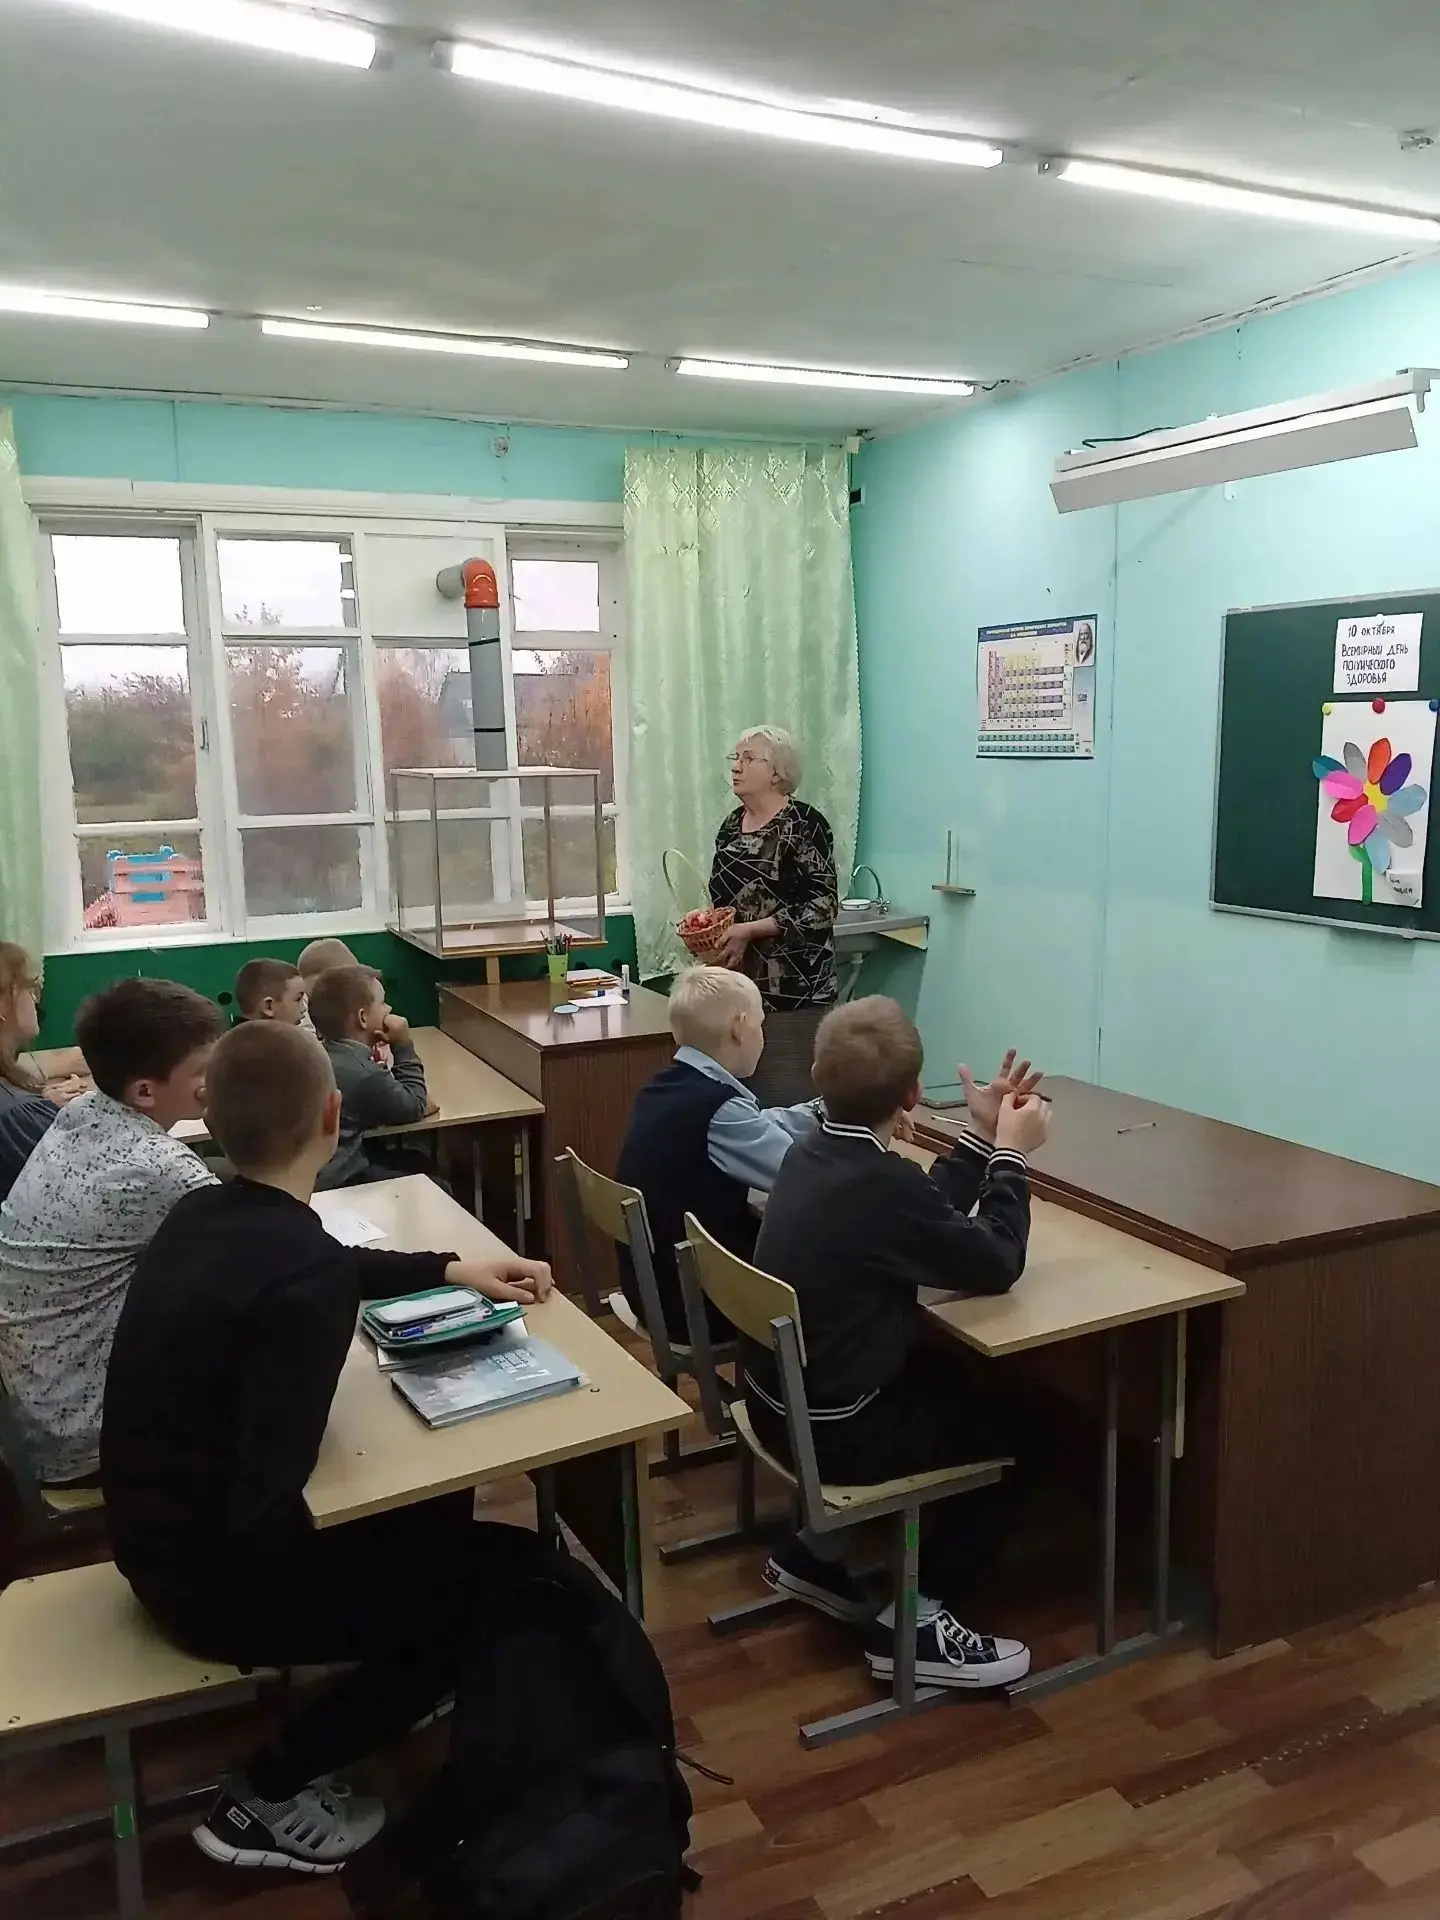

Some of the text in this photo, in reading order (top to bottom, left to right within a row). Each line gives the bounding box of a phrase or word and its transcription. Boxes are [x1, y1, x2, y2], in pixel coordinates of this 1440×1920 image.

[1348, 624, 1357, 637] 10
[1386, 643, 1409, 656] ДЕНЬ
[1346, 672, 1387, 686] ЗДОРОВЬЯ
